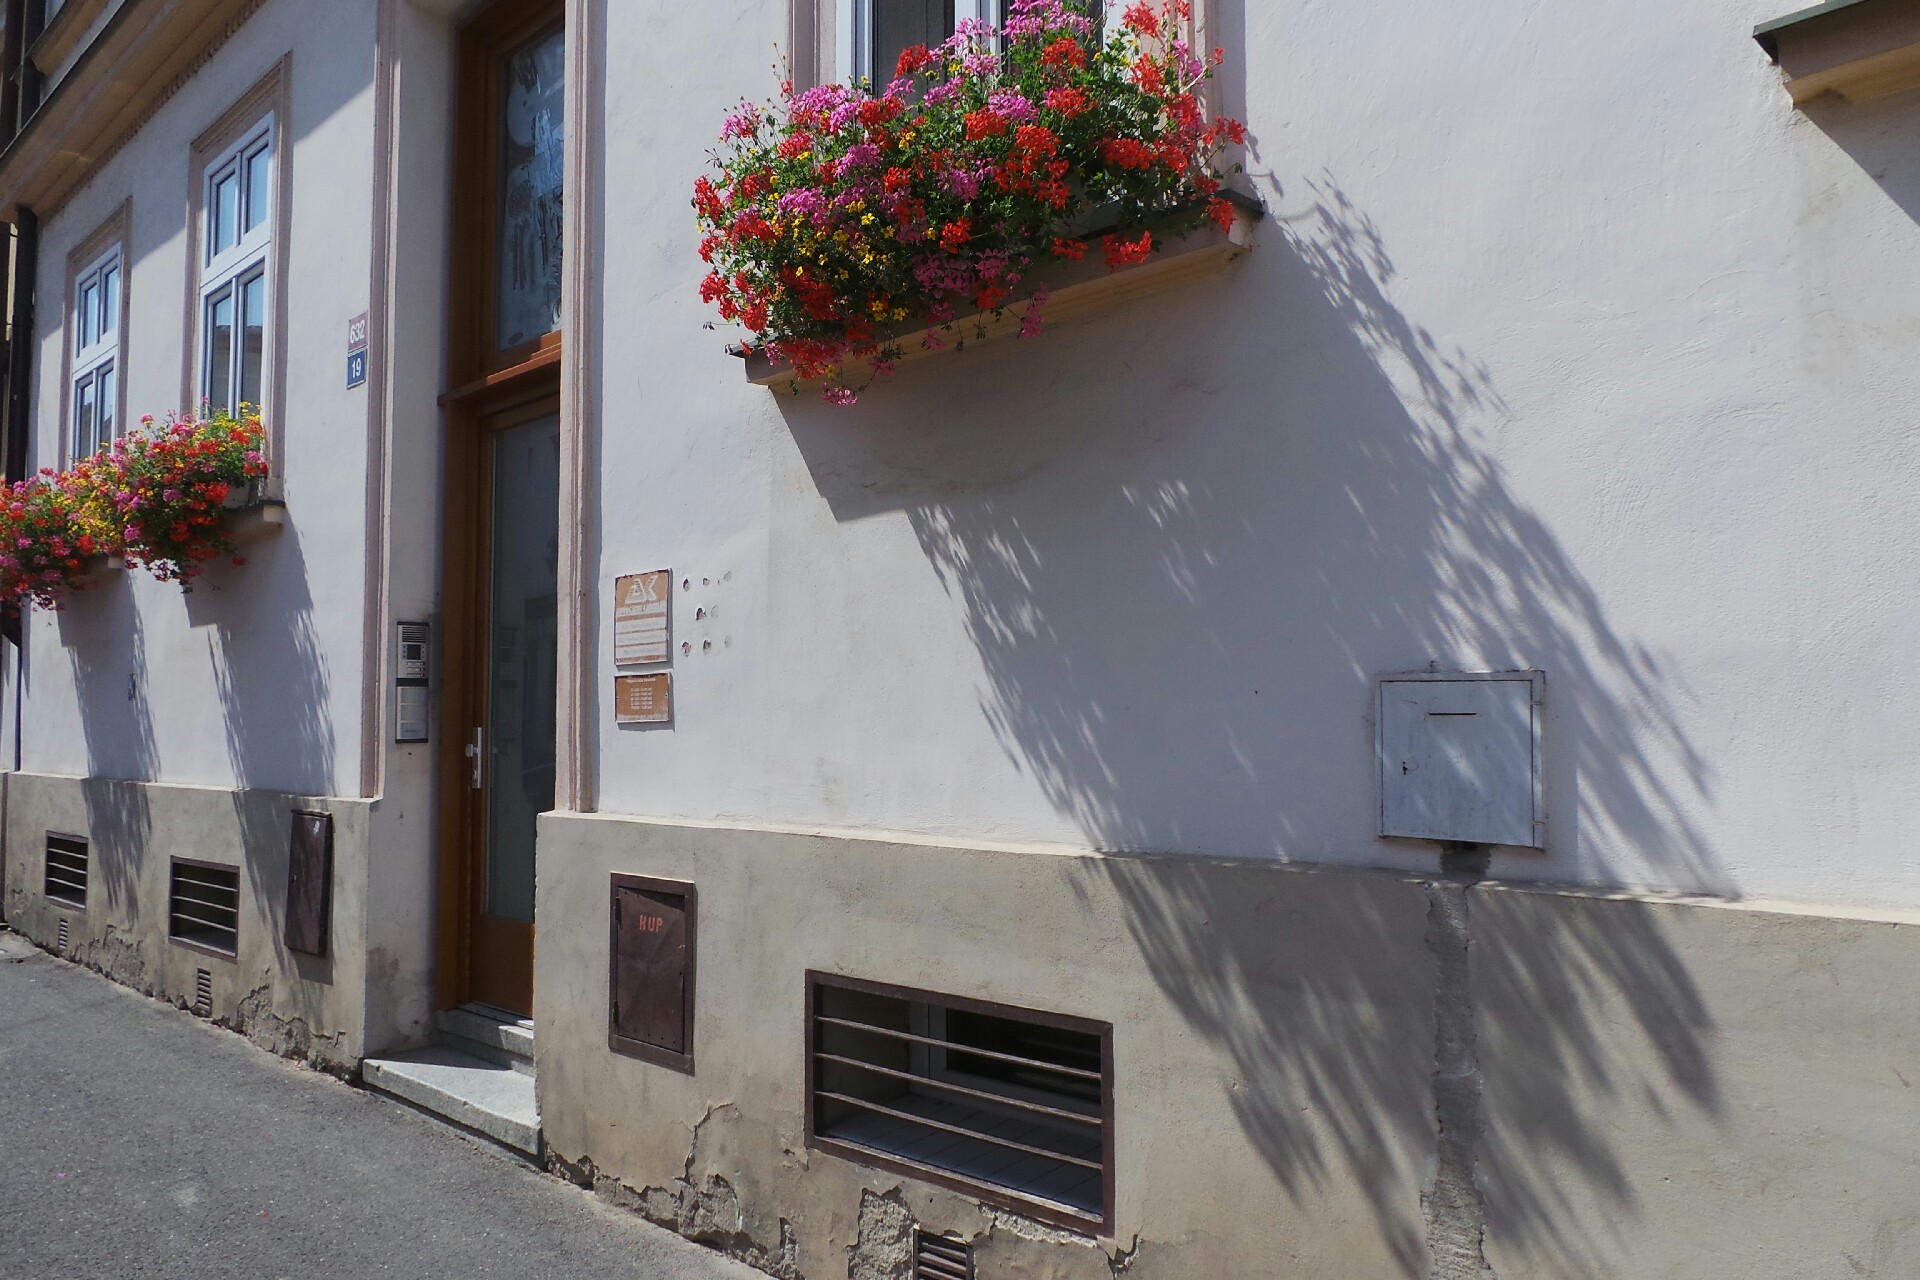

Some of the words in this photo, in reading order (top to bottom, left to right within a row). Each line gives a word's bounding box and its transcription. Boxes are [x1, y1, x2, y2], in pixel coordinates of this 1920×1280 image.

[350, 320, 365, 343] 632
[352, 358, 362, 378] 19
[624, 575, 658, 604] AK
[640, 915, 663, 932] HUP
